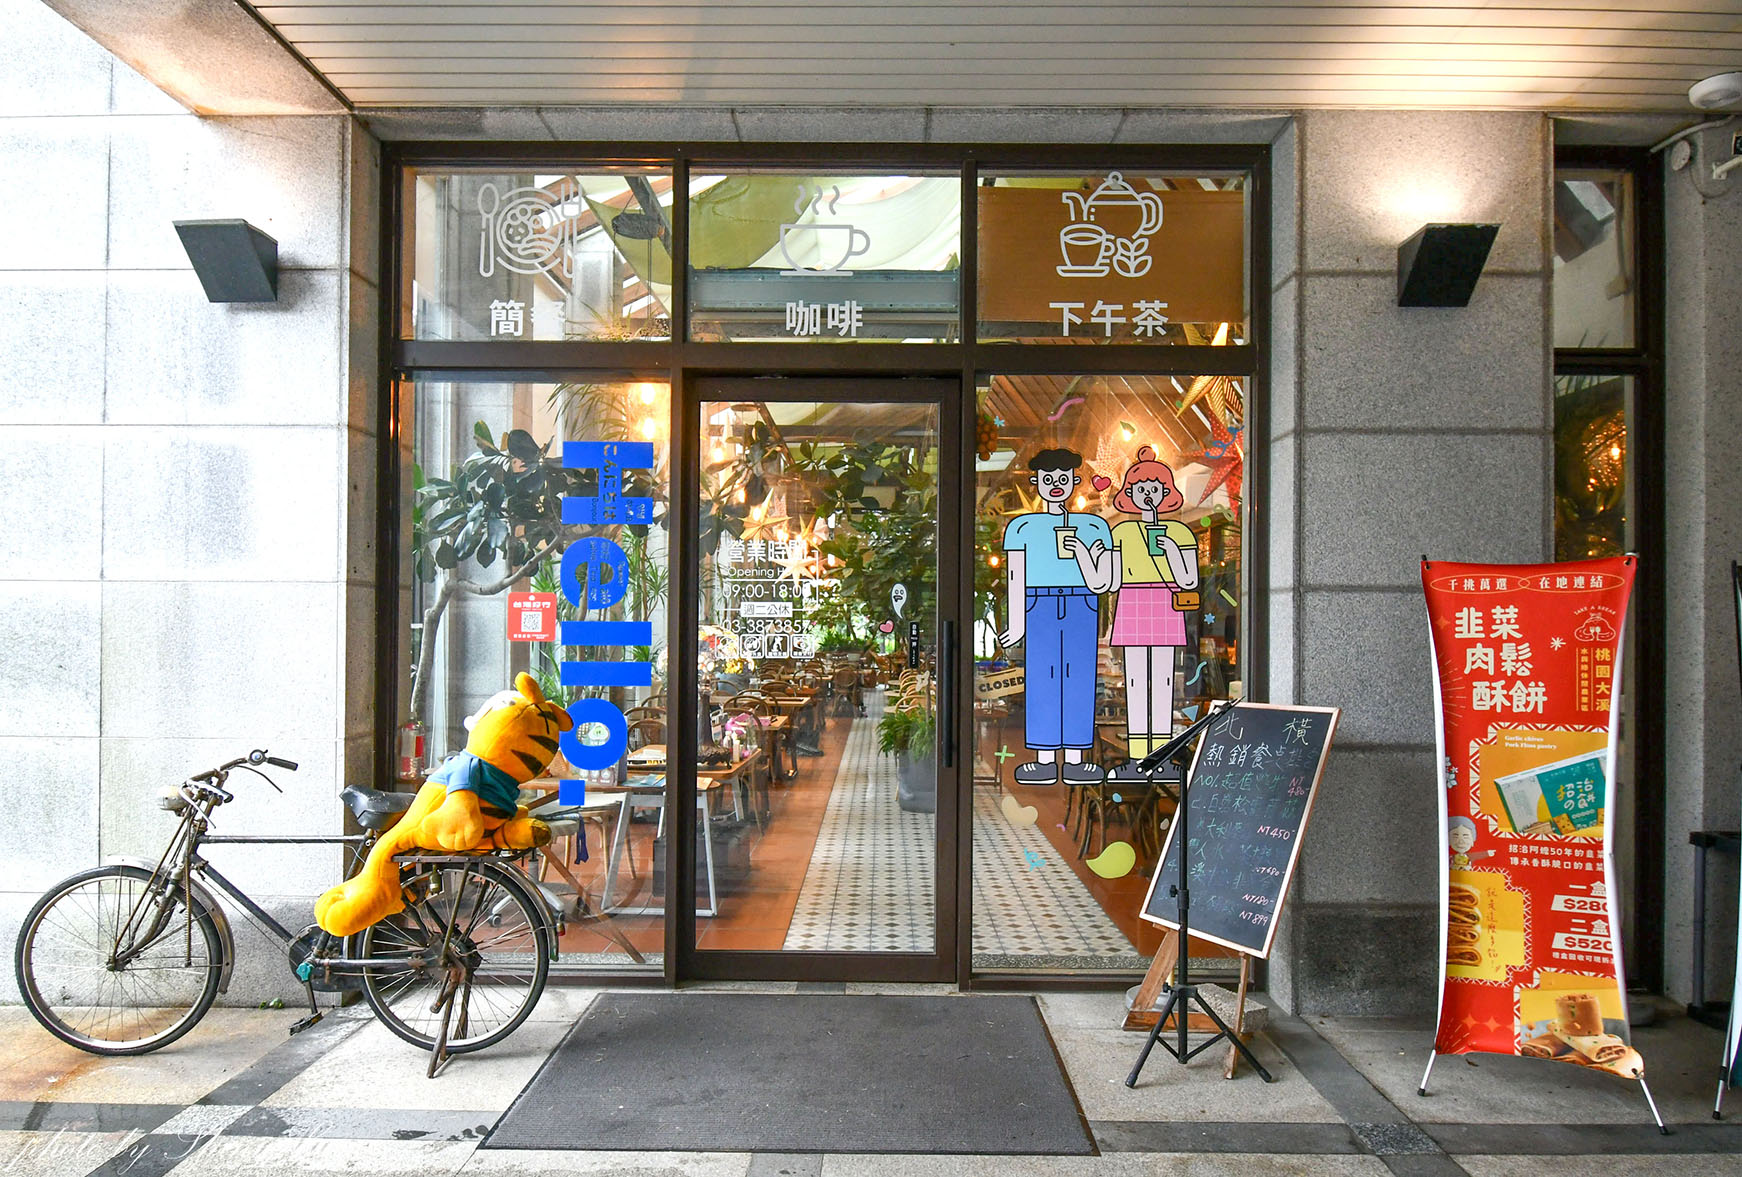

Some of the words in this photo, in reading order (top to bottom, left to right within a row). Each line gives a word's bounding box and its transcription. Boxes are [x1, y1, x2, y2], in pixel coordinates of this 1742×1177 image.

[785, 299, 864, 337] 咖啡
[1048, 299, 1169, 337] 下午茶
[603, 444, 618, 521] こんにちは
[728, 567, 775, 579] Opening
[1447, 577, 1508, 591] 千桃萬選
[1538, 575, 1604, 590] 在地連結
[743, 604, 790, 616] 週二公休
[1454, 604, 1523, 640] 韭菜
[1463, 642, 1534, 677] 肉鬆
[978, 676, 1025, 693] CLOSED
[1472, 679, 1548, 714] 酥餅
[1595, 647, 1611, 712] 桃園大溪
[1568, 880, 1606, 897] 一盒
[1570, 918, 1609, 936] 二盒
